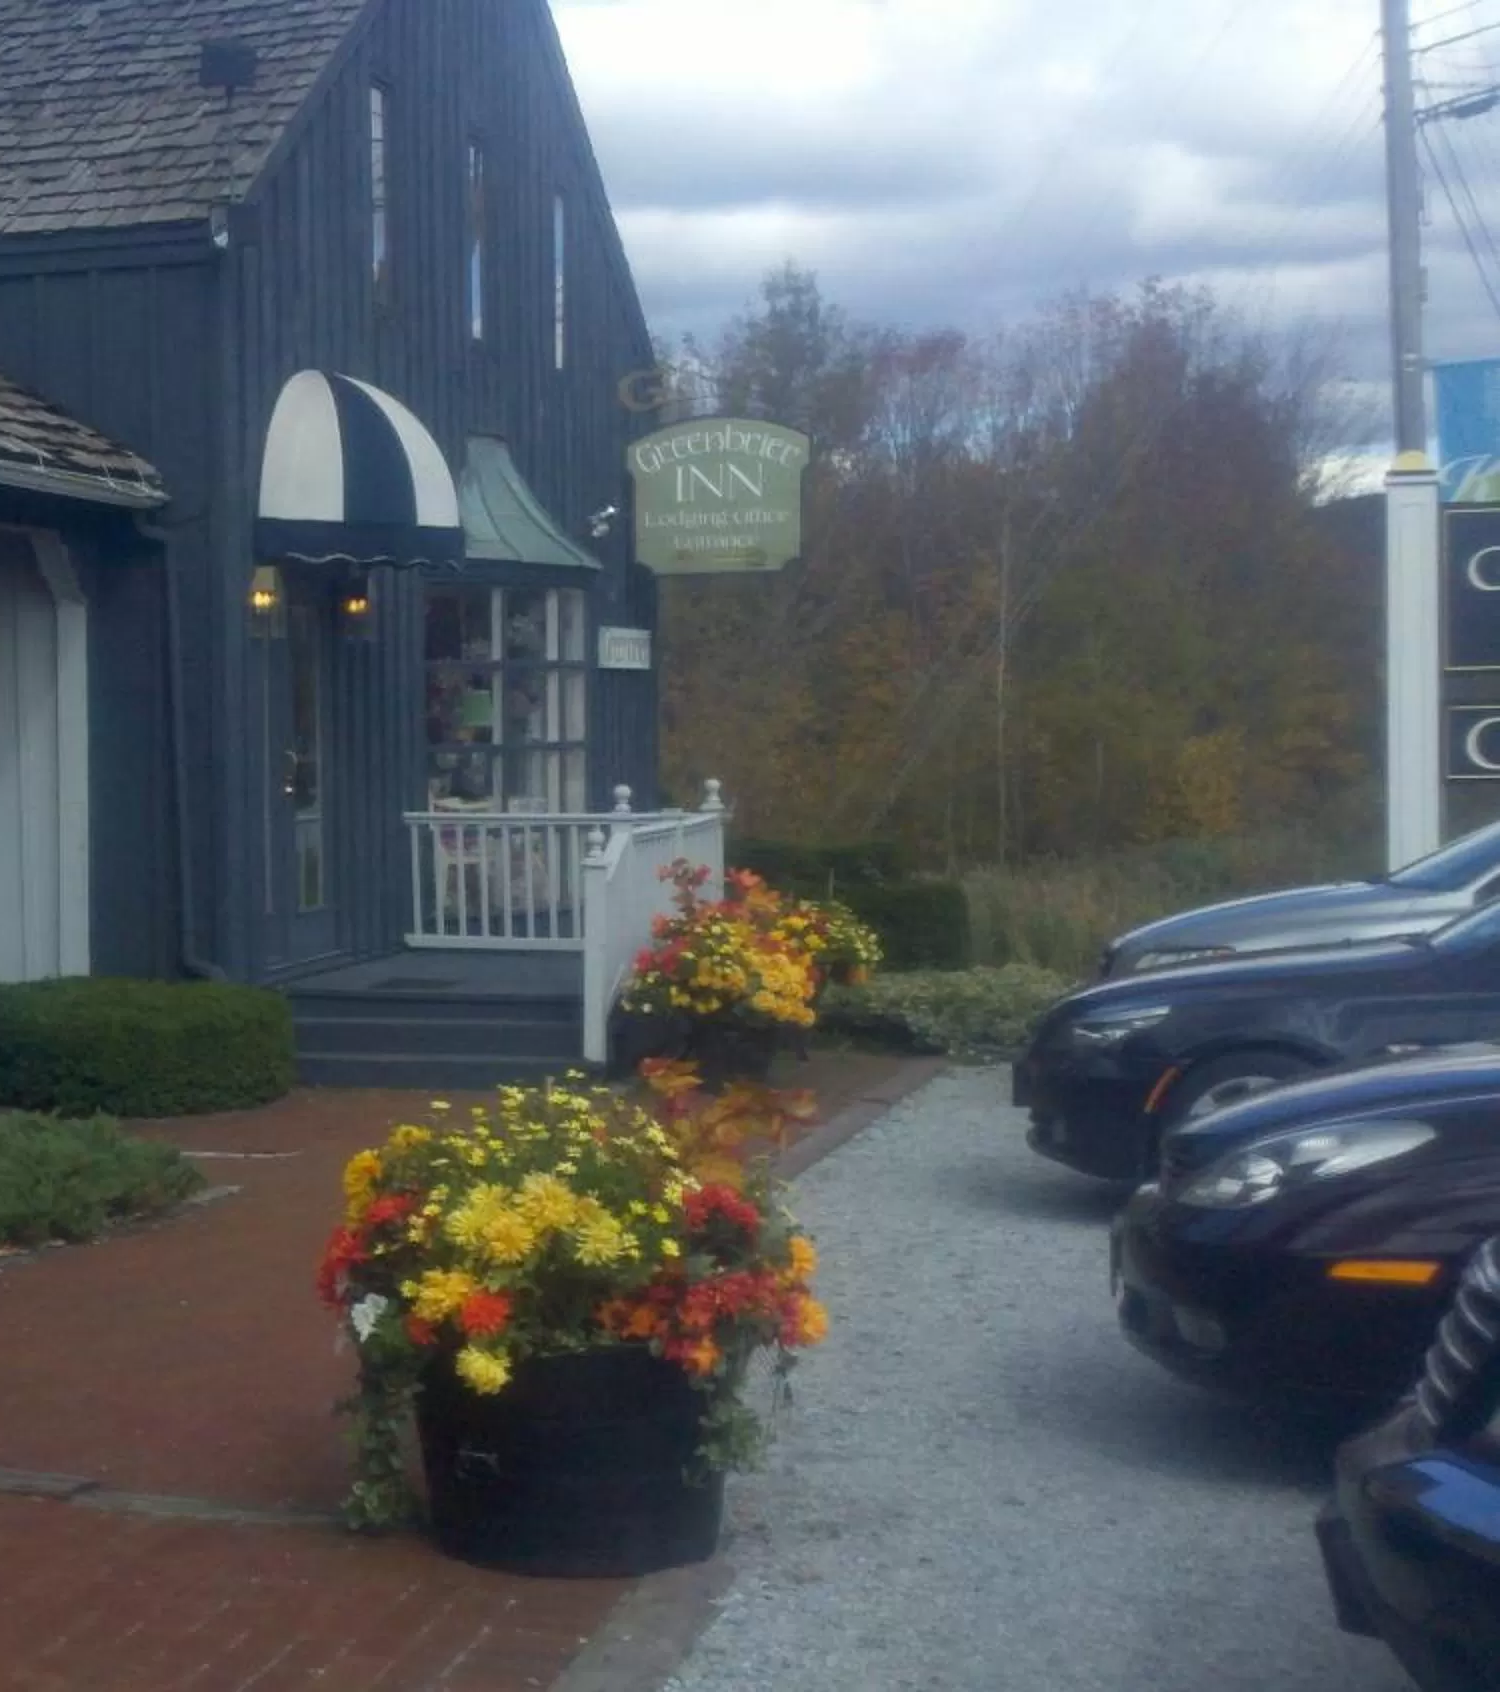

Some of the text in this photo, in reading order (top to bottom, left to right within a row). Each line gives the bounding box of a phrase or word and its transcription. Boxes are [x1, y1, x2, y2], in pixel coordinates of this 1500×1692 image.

[634, 423, 800, 474] Greenbrier
[675, 463, 764, 502] INN
[644, 509, 729, 530] Lodging
